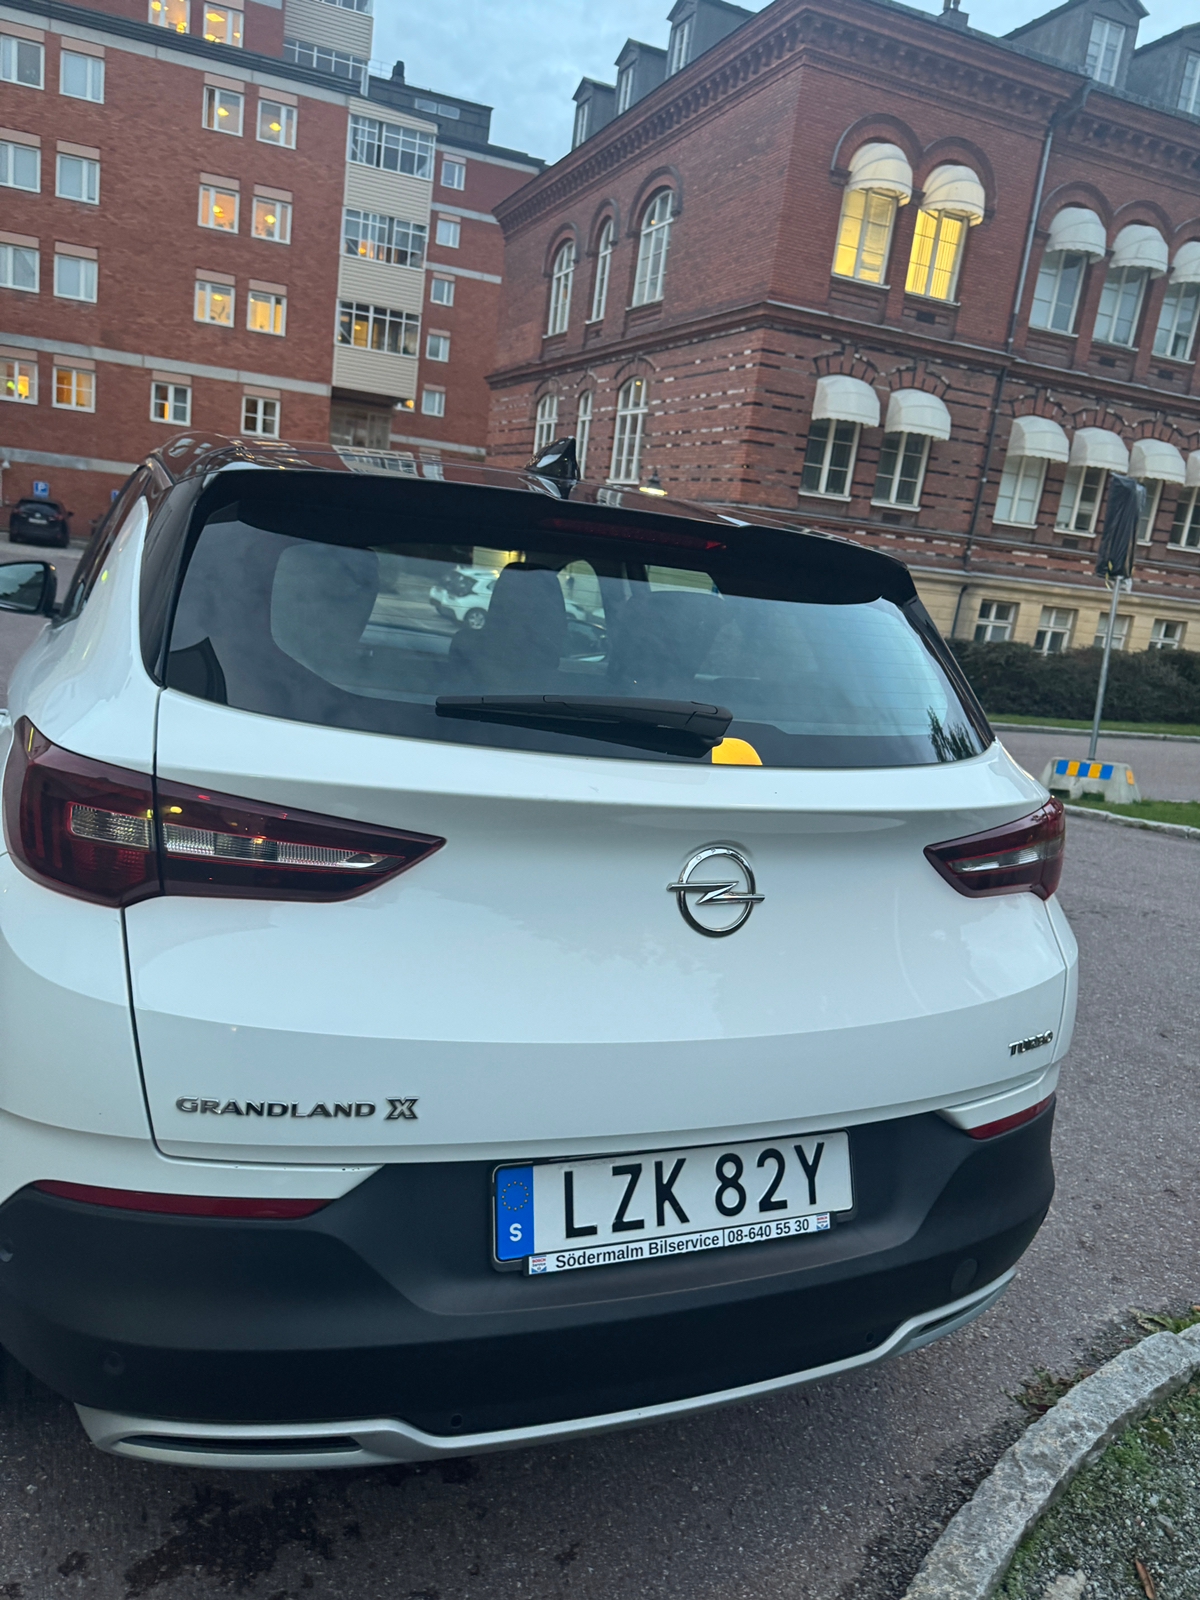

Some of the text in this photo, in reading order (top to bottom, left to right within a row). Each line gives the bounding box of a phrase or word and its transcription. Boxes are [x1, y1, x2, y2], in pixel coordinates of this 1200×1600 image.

[1008, 1029, 1053, 1056] TURBO
[176, 1096, 420, 1120] GRANDLAND X
[564, 1142, 825, 1239] LZK 82Y
[509, 1223, 522, 1242] S
[555, 1218, 809, 1269] Södermalm Bilservice 08-640 55 30
